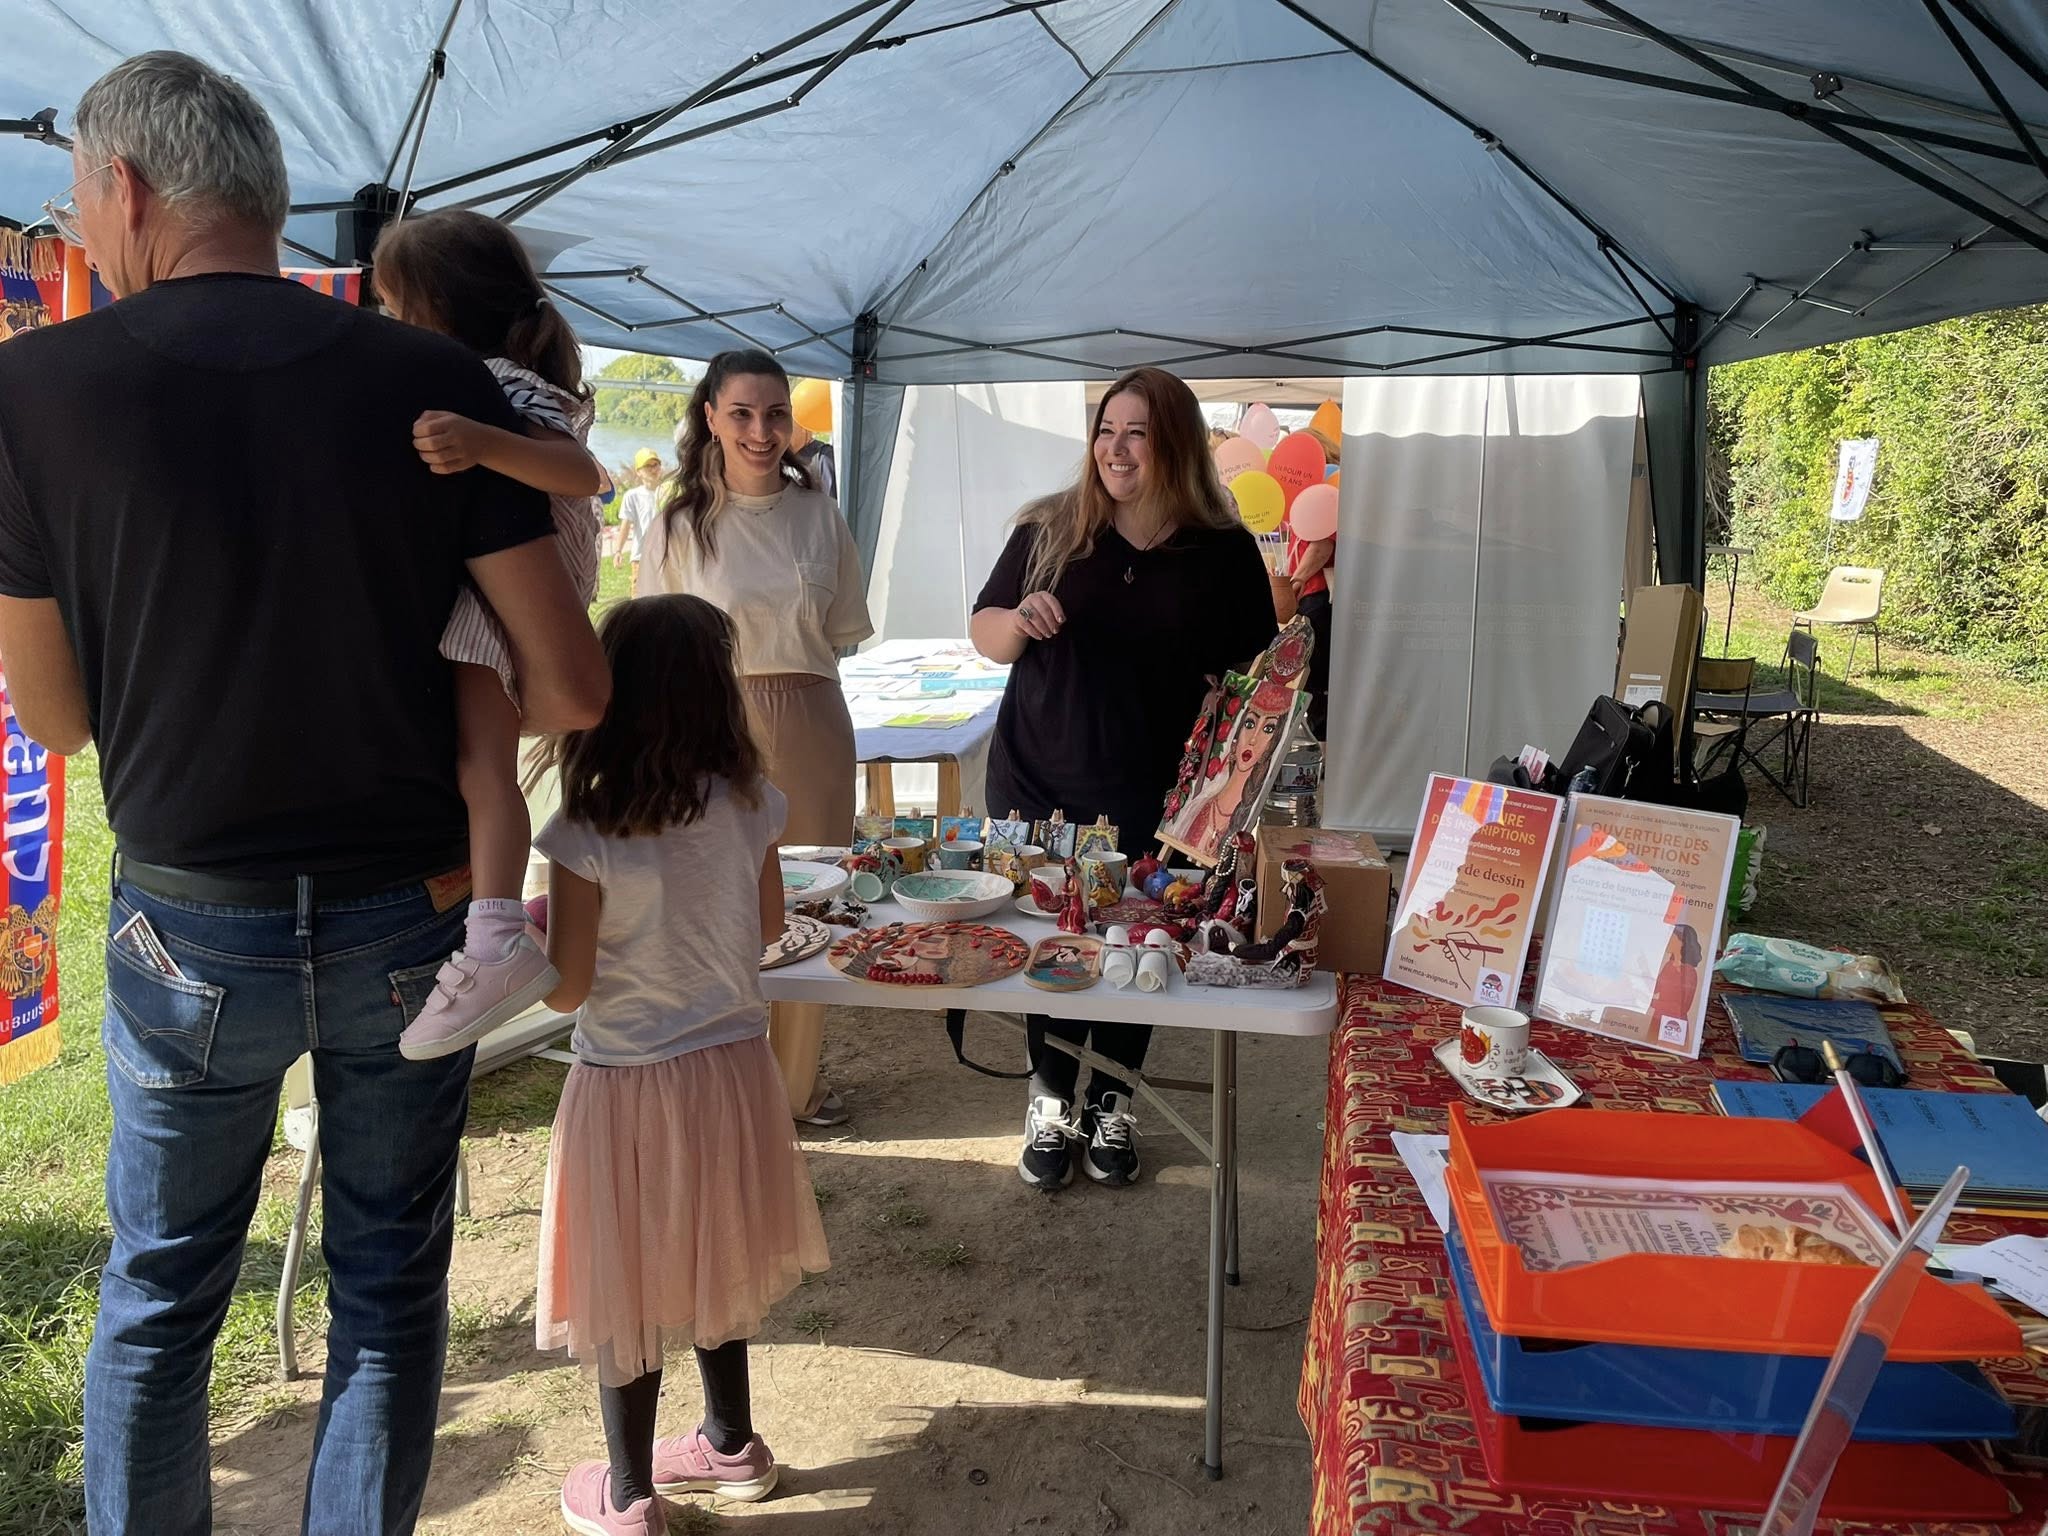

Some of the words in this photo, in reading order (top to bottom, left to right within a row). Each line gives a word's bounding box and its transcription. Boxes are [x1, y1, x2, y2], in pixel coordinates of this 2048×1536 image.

[1282, 465, 1302, 476] POUR
[1431, 813, 1454, 831] DES
[1455, 818, 1537, 846] INSCRIPTIONS
[1591, 822, 1681, 848] OUVERTURE
[1684, 837, 1710, 852] DES
[1467, 840, 1501, 853] eptembre
[1502, 846, 1521, 857] 2025
[1588, 836, 1702, 866] INCRIPTIONS
[1464, 863, 1481, 878] de
[1483, 868, 1526, 889] dessin
[1671, 868, 1691, 878] 2025
[1571, 875, 1600, 889] Cours
[1601, 879, 1615, 890] de
[1616, 881, 1650, 898] langue
[1680, 880, 1707, 891] Avignon
[478, 900, 507, 911] GIRL
[1398, 964, 1460, 990] www.mca-avignon.org
[1480, 988, 1500, 1001] MCA
